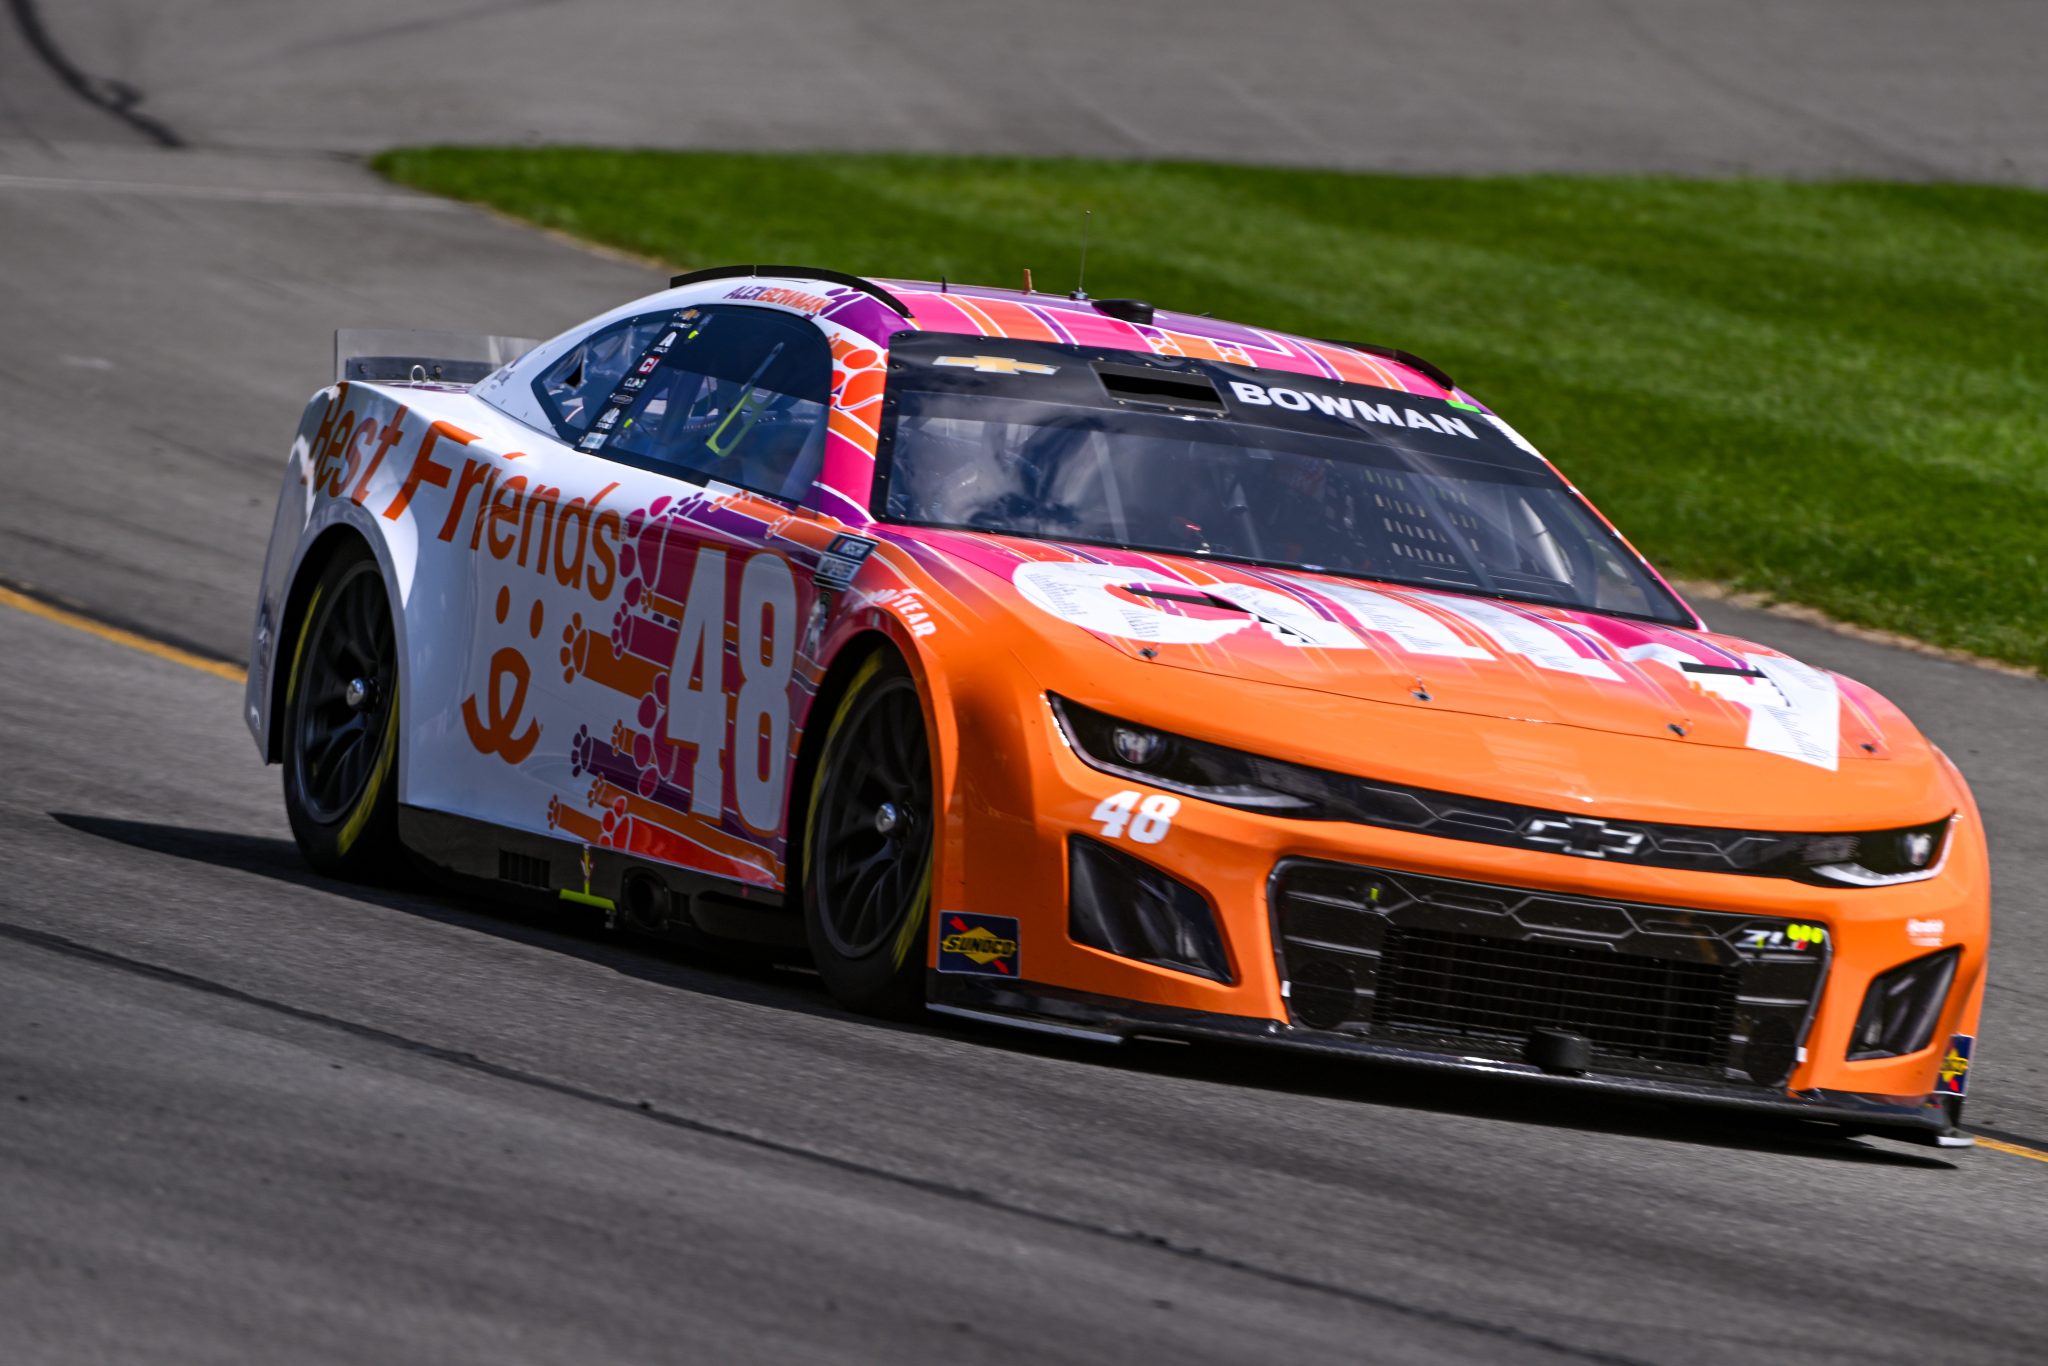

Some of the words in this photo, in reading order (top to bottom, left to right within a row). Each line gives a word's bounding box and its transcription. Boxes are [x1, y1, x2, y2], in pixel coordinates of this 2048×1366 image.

[1228, 381, 1479, 440] BOWMAN
[382, 420, 621, 602] Friends
[666, 543, 798, 837] 48
[1091, 789, 1181, 844] 48
[945, 935, 1014, 956] SUNOCO
